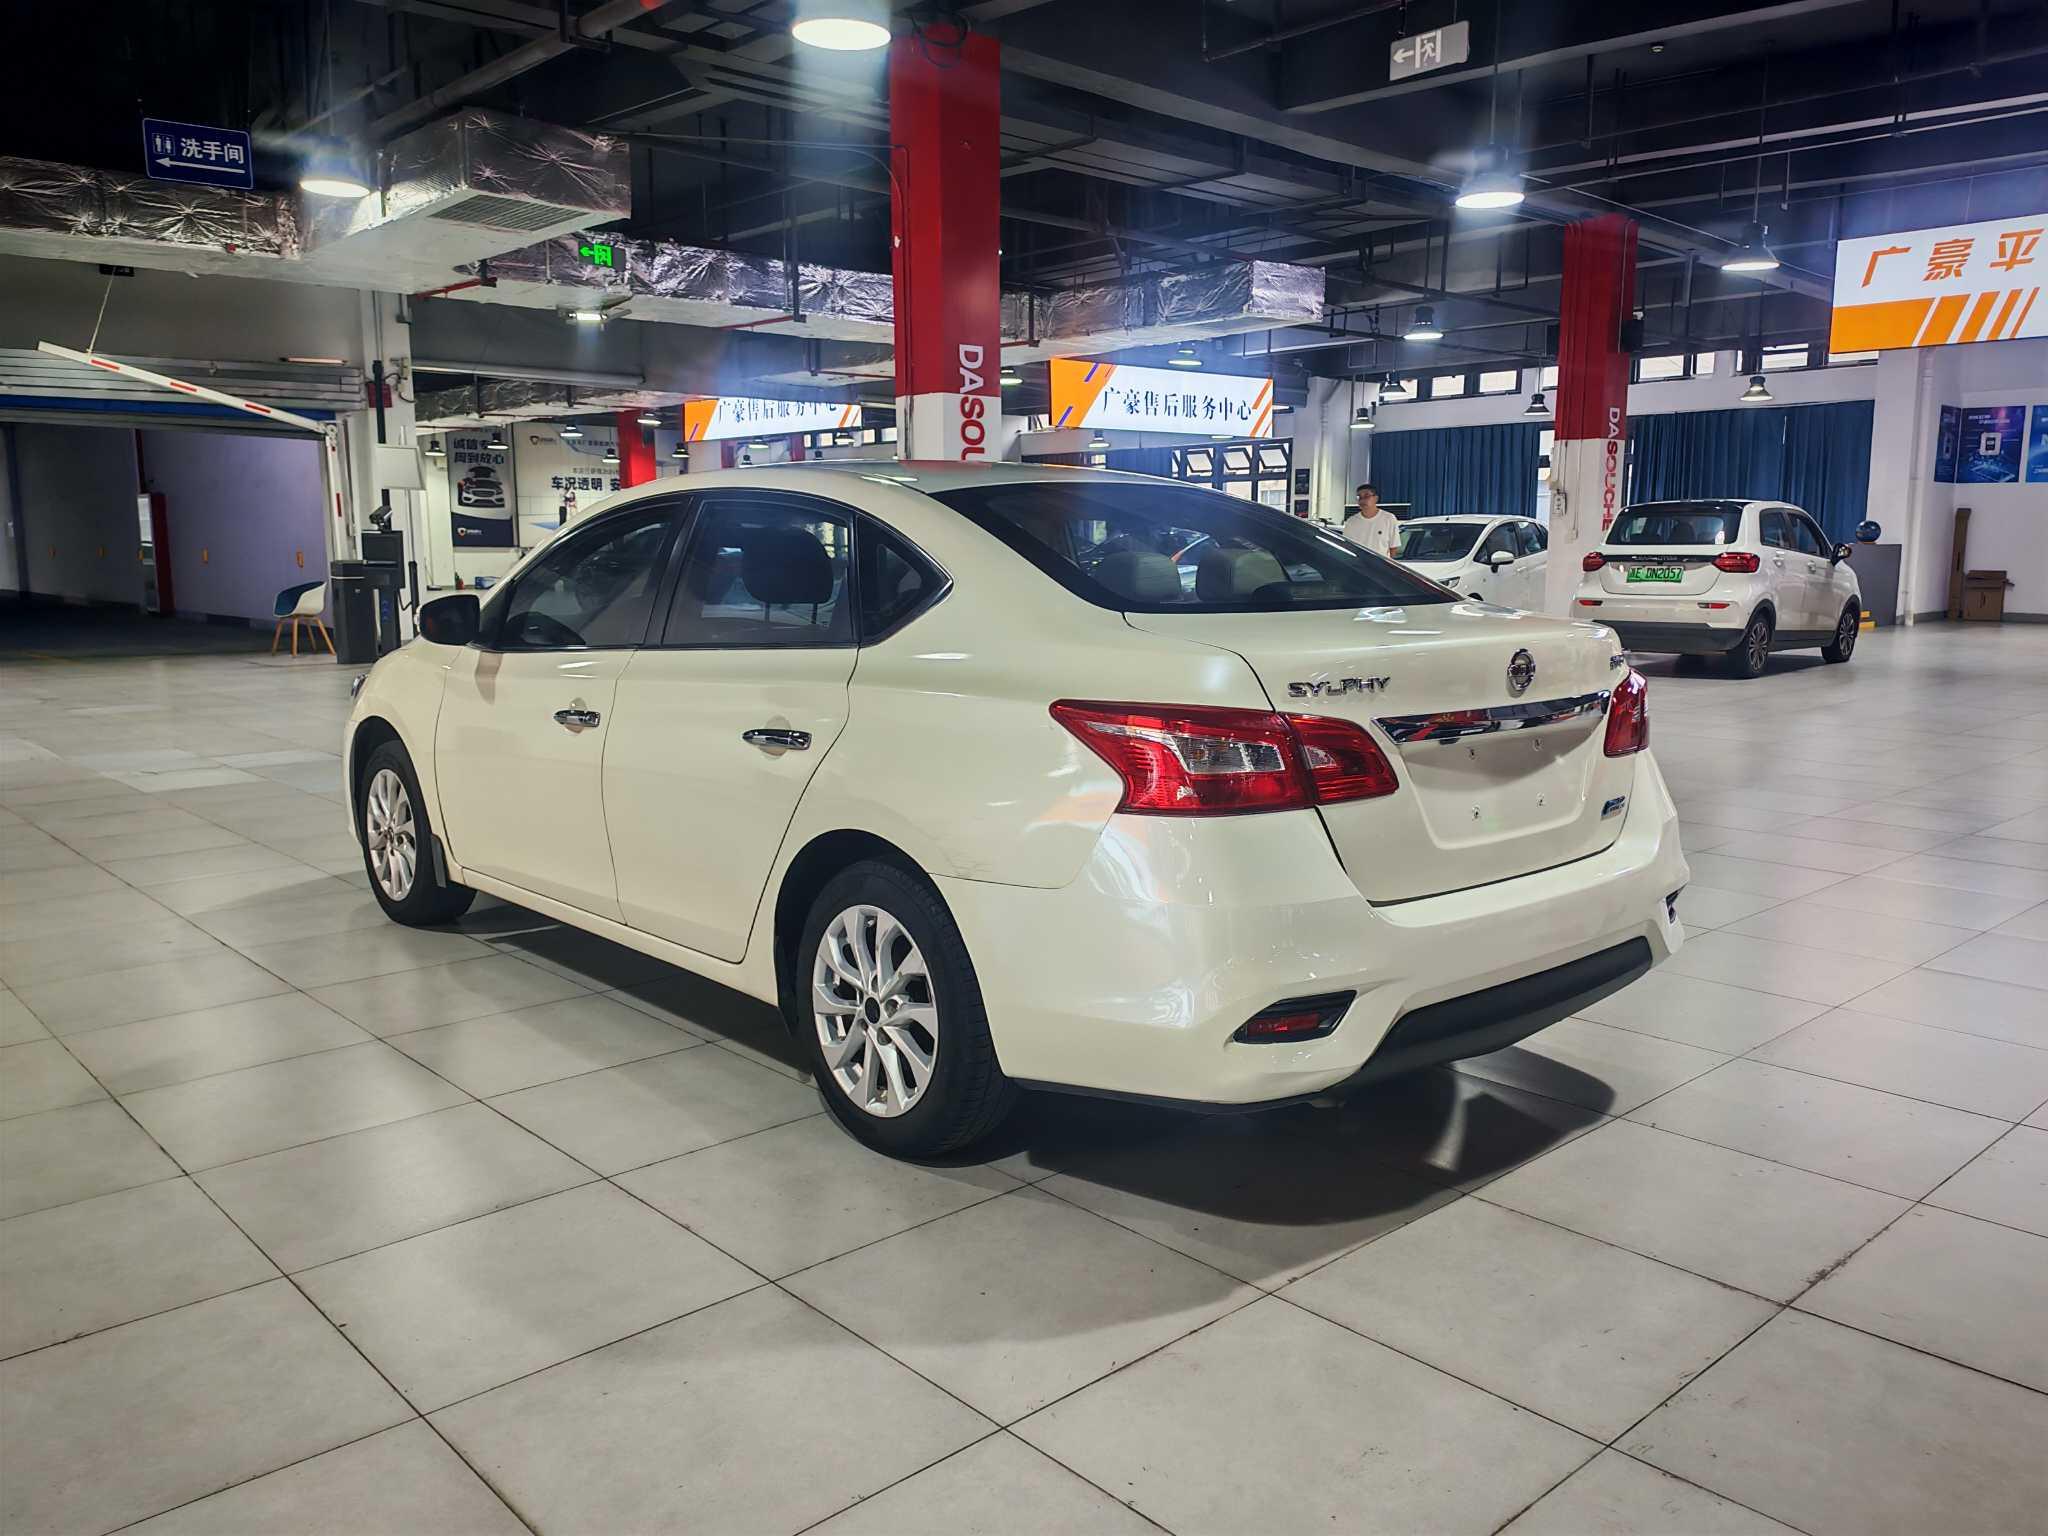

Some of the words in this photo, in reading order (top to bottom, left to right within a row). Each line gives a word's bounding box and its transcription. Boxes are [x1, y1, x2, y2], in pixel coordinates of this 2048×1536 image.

[180, 138, 245, 164] 洗手间
[1861, 228, 2045, 288] 广豪平
[1103, 387, 1252, 421] 广豪售后服务中心
[551, 476, 602, 491] 车况透明
[1602, 407, 1620, 532] DASOUCHE
[1288, 677, 1391, 697] SYLPHY
